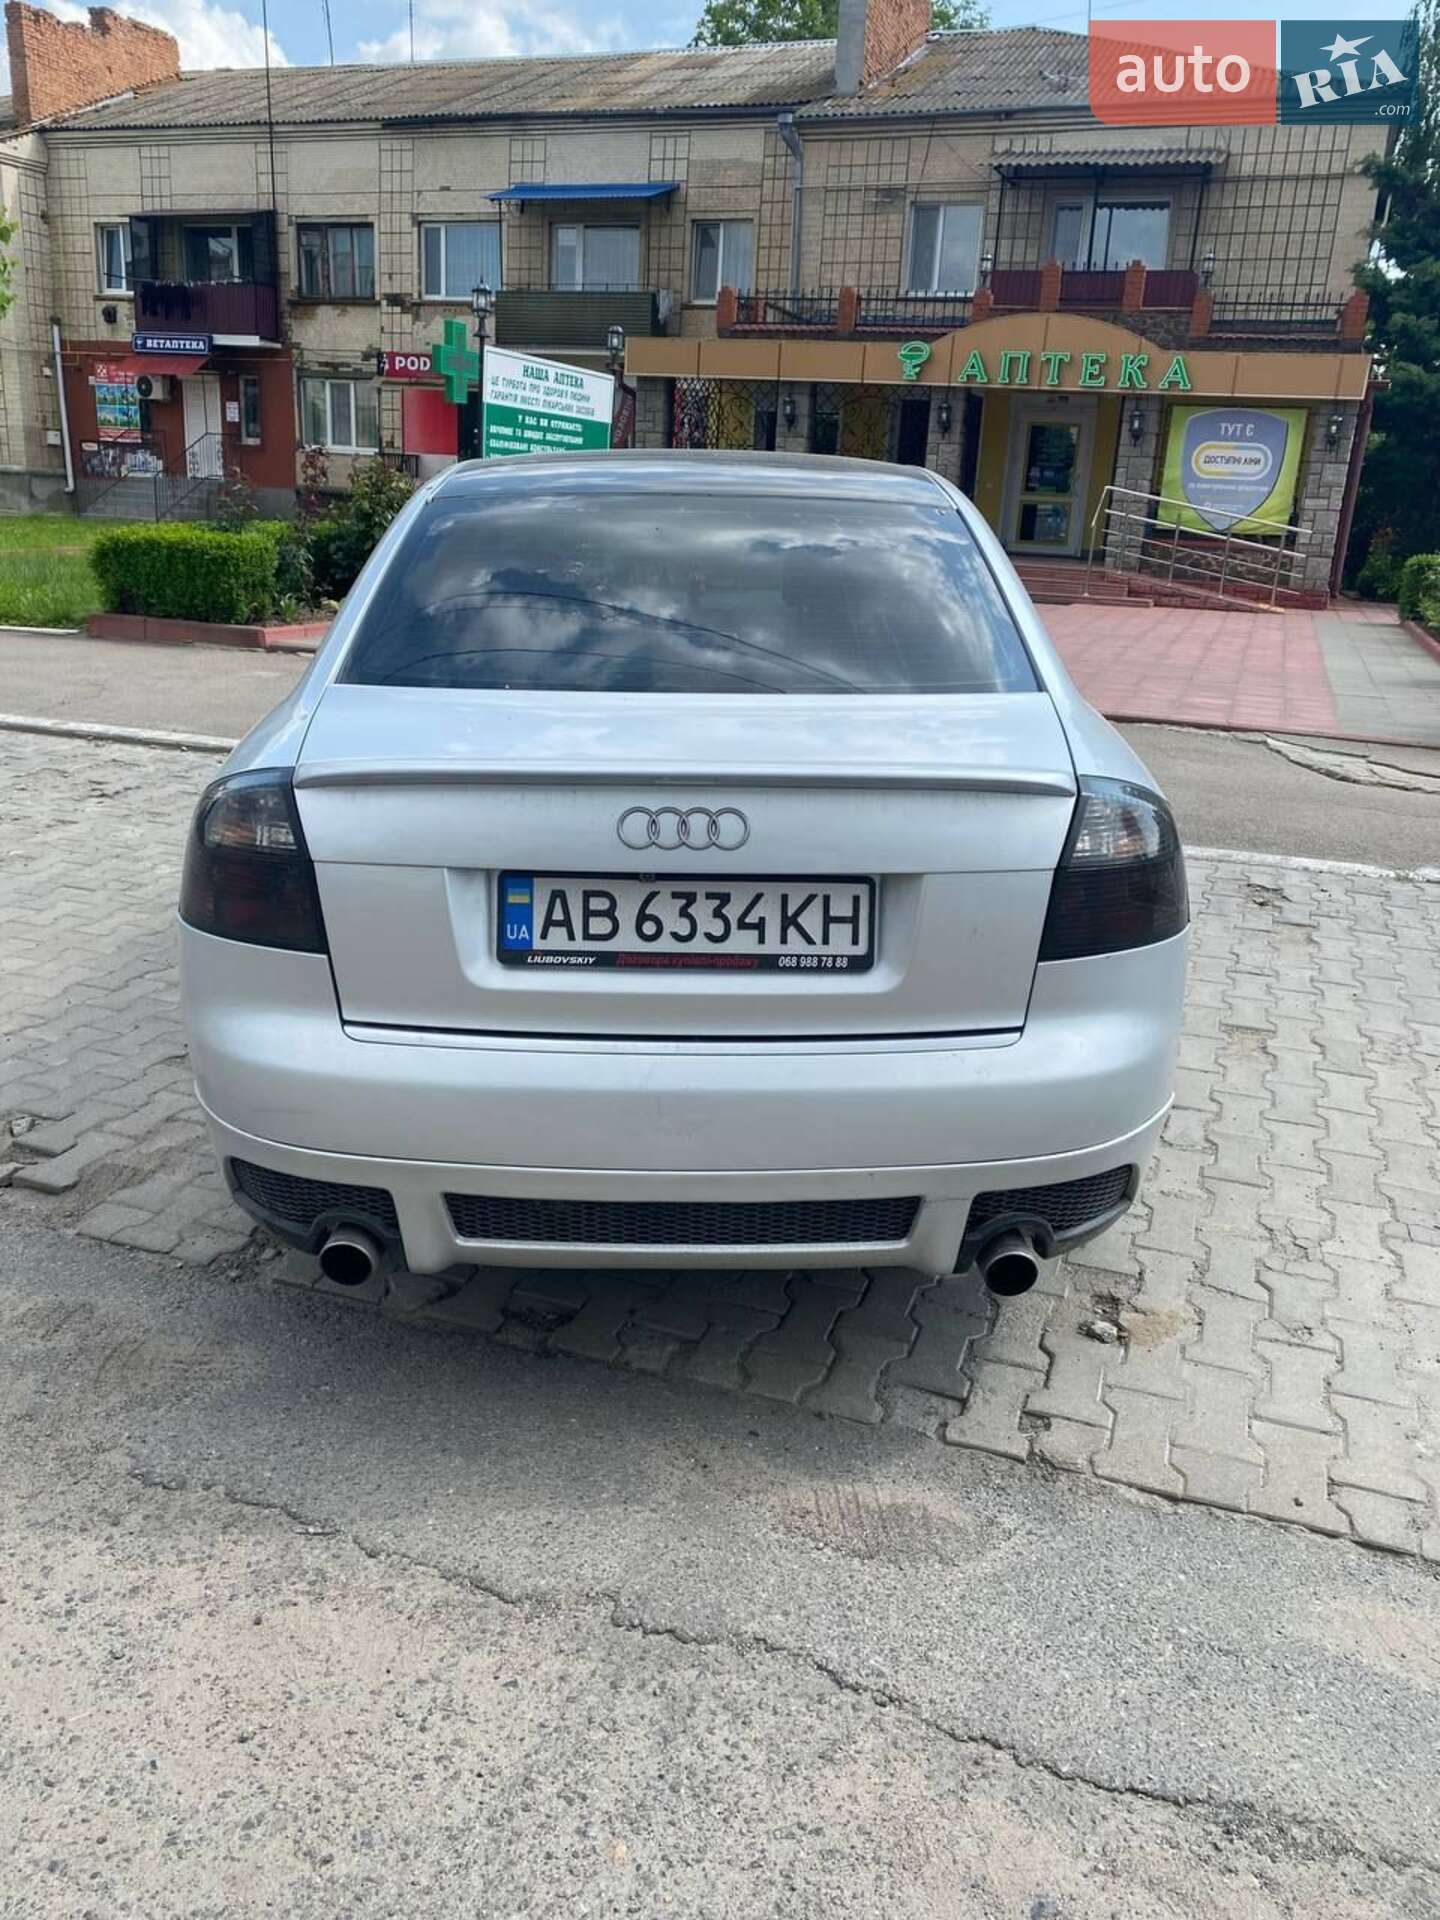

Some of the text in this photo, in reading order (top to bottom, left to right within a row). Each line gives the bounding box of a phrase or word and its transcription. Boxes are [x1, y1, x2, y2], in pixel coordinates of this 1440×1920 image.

[146, 338, 205, 350] ВЕТАПТЕКА
[395, 356, 431, 371] POD
[958, 349, 1192, 391] АПТЕКА
[522, 364, 585, 390] НАША АПТЕКА
[1220, 422, 1244, 437] ТУТ
[539, 888, 620, 943] AB
[506, 923, 530, 940] UA
[527, 955, 597, 965] LIUBOVSKIY
[778, 956, 849, 969] 068 988 78 88
